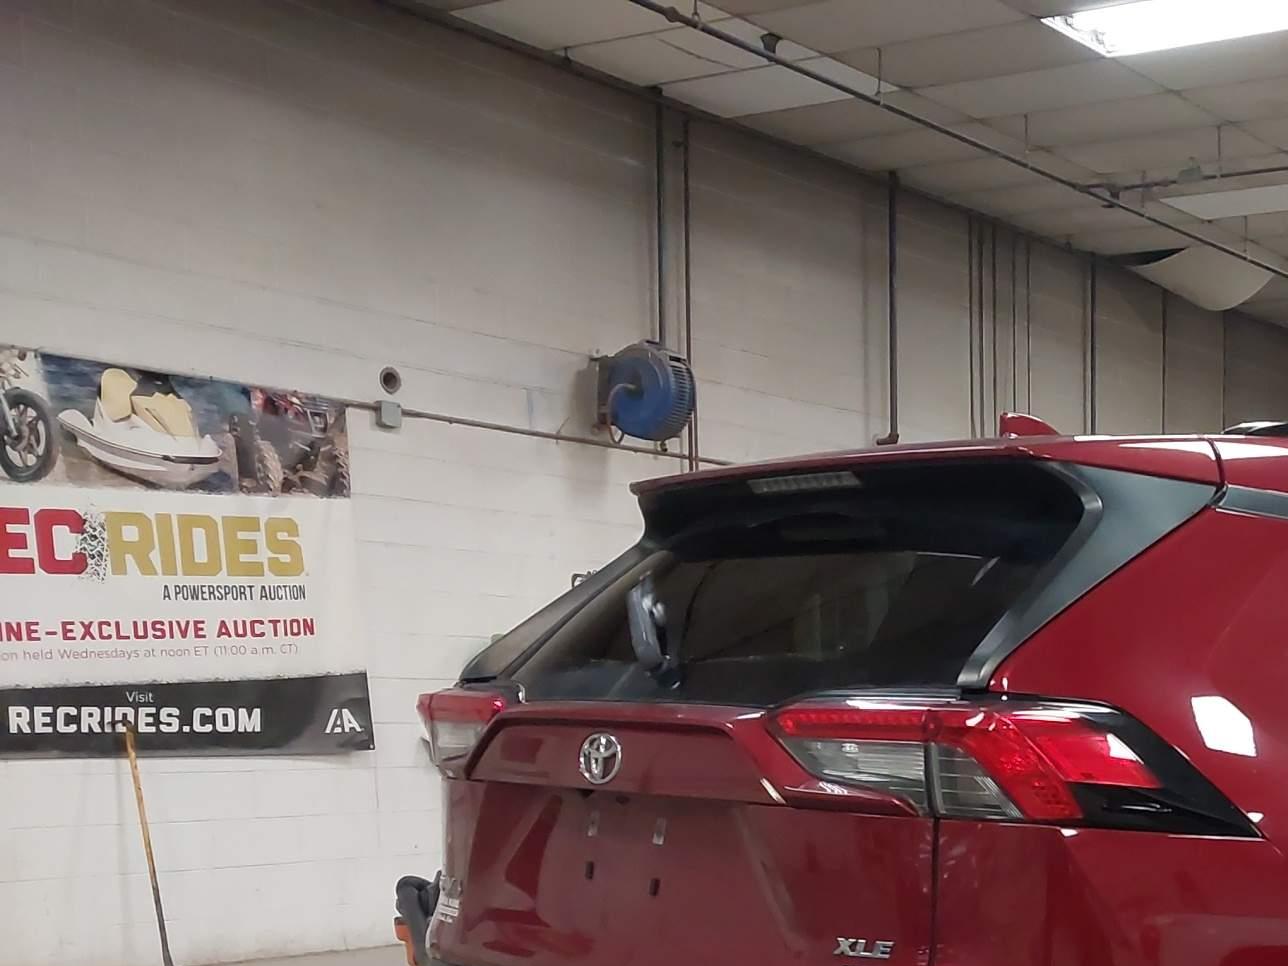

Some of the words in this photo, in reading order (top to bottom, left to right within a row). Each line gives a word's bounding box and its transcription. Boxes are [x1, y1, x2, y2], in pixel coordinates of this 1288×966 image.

[102, 511, 305, 577] RIDES
[163, 584, 171, 601] A
[174, 584, 255, 601] POWERSPORT
[259, 584, 306, 601] AUCTION
[216, 618, 316, 639] AUCTION
[23, 648, 53, 661] held
[58, 647, 140, 660] Wednesdays
[144, 647, 156, 658] at
[160, 648, 191, 657] noon
[194, 645, 209, 657] ET
[125, 690, 154, 703] Visit
[7, 705, 262, 735] RECRIDES.COM
[833, 937, 895, 959] XLE
